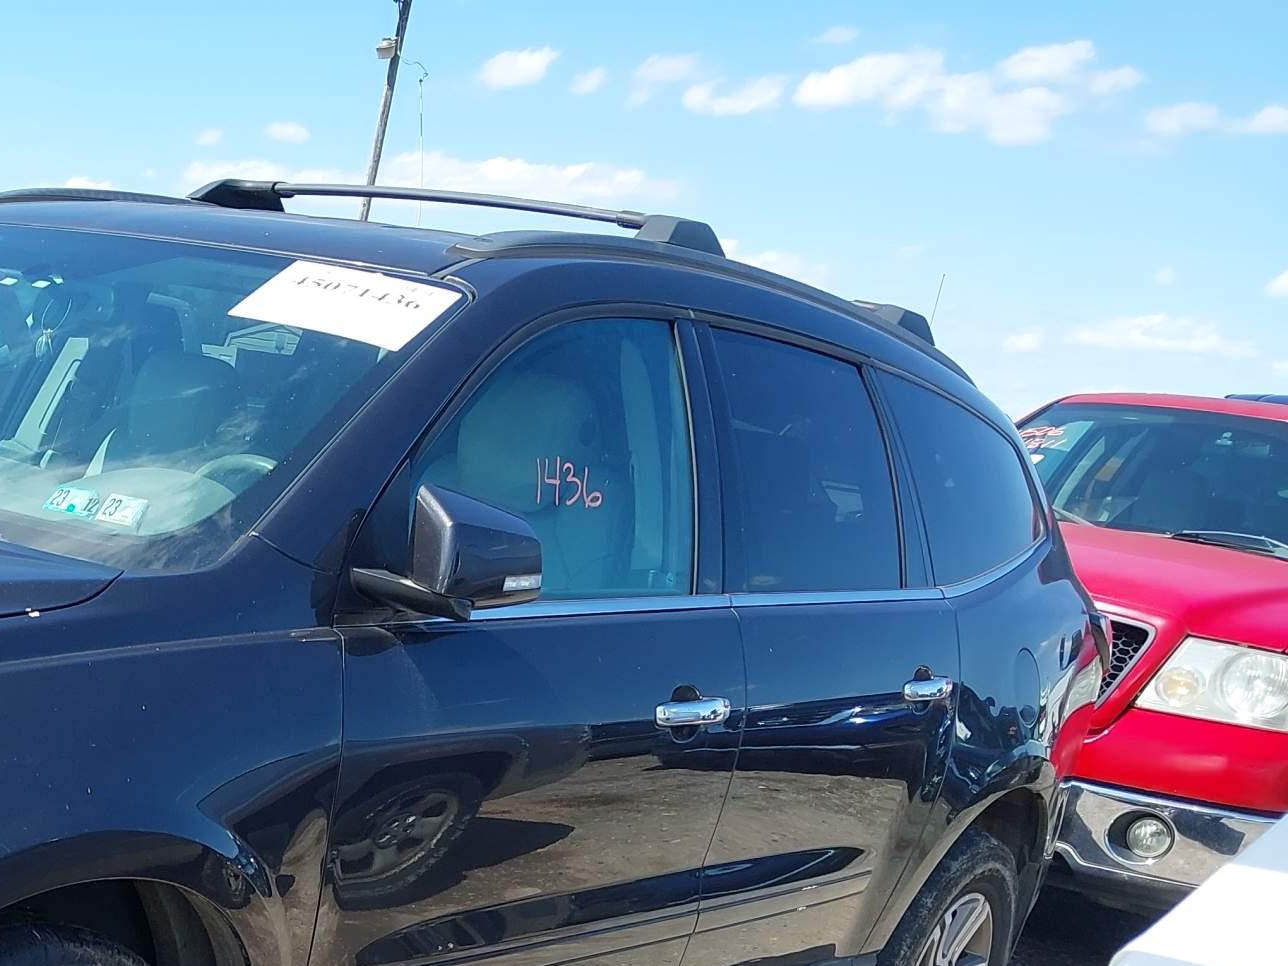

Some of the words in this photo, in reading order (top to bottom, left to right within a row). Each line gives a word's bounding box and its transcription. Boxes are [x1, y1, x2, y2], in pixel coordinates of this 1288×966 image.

[536, 455, 603, 509] 1436
[50, 489, 71, 507] 23
[103, 498, 123, 517] 23
